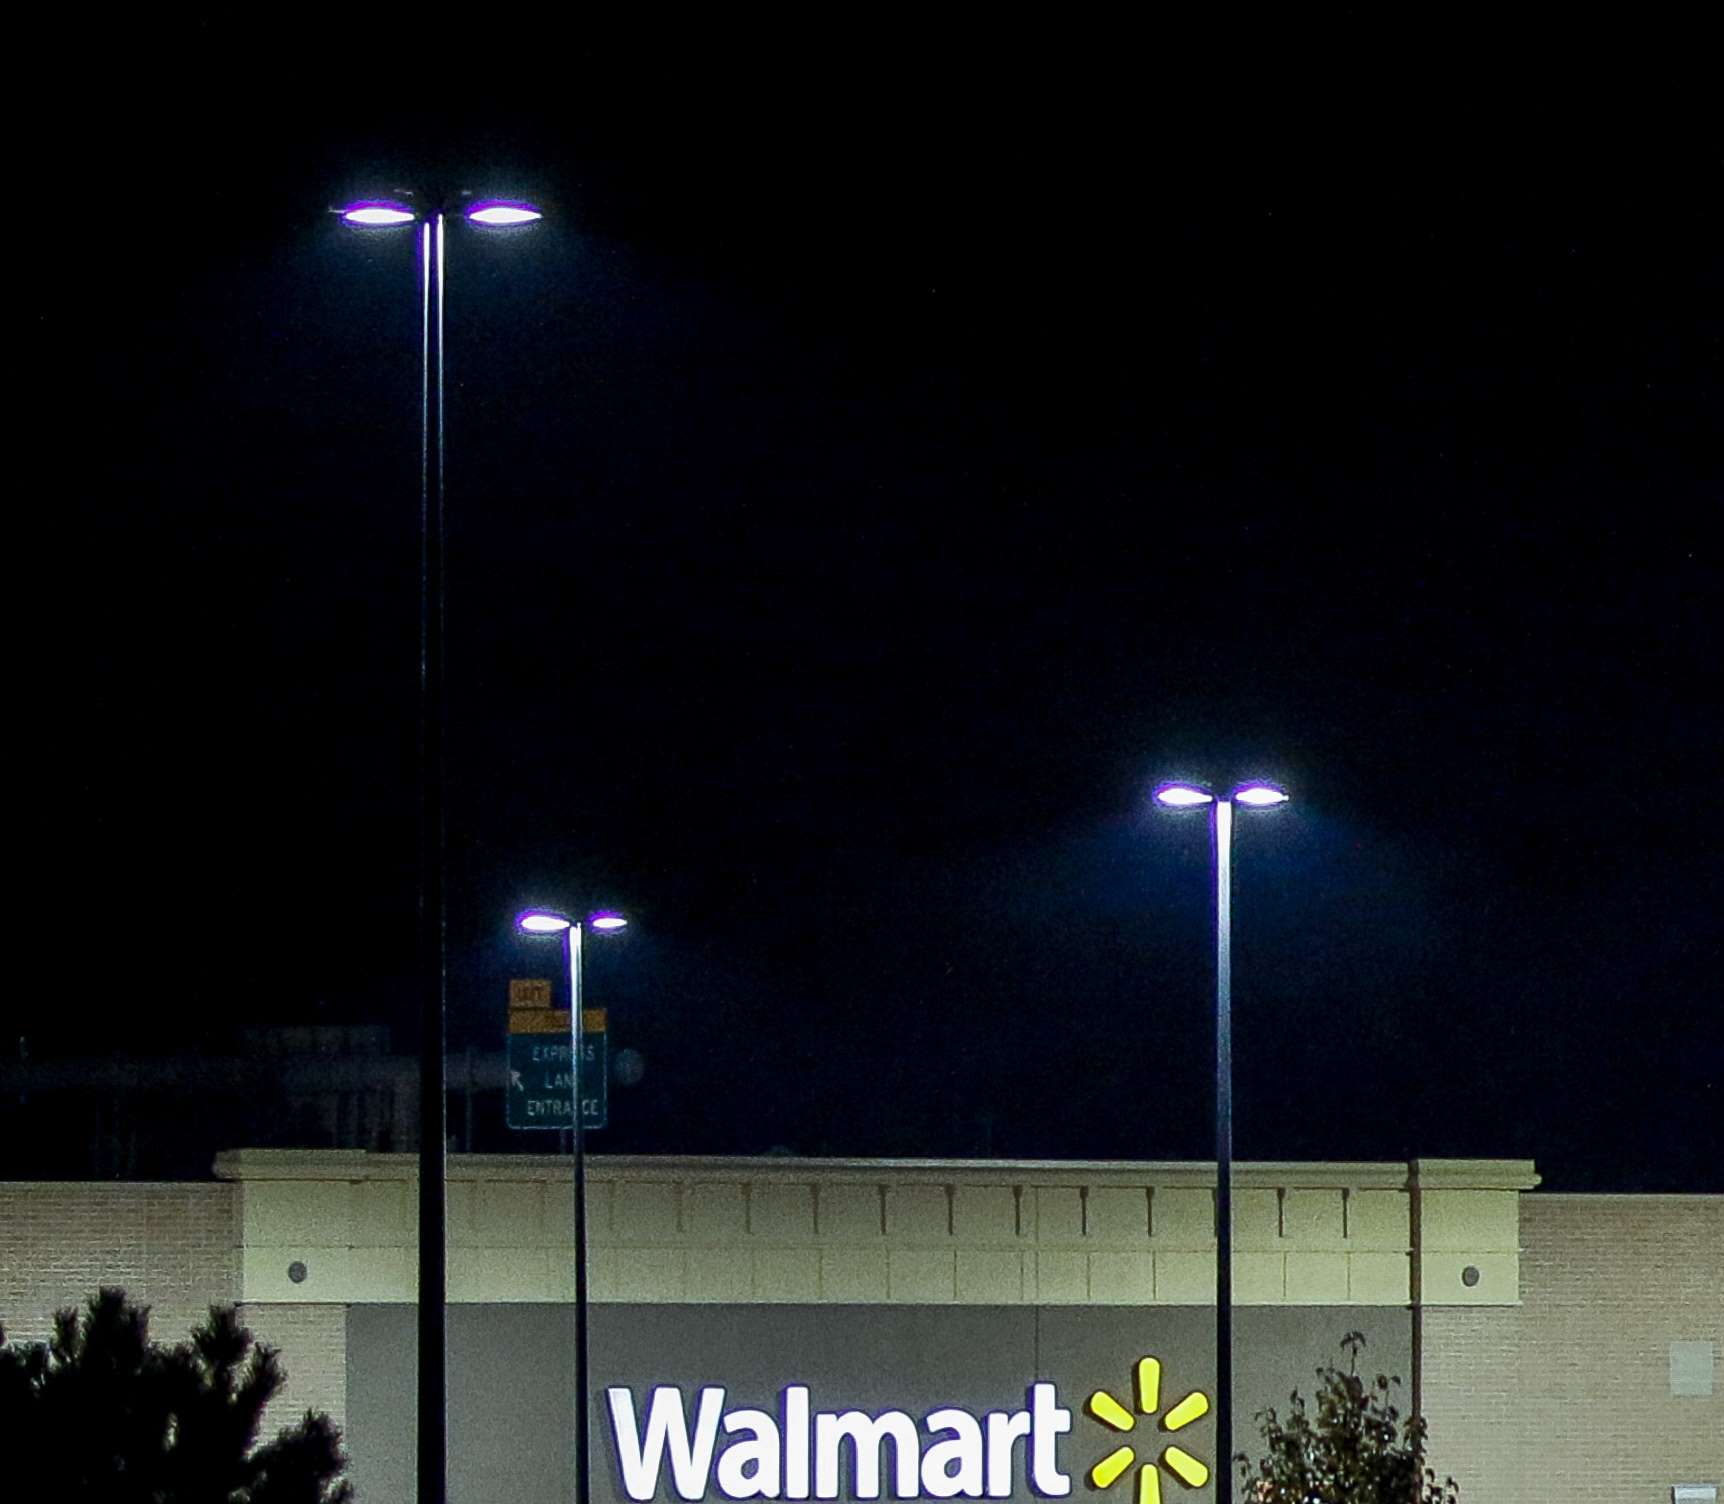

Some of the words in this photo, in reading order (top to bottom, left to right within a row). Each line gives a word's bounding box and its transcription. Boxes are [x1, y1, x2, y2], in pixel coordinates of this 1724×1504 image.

[532, 1045, 595, 1061] EXPRS
[544, 1072, 583, 1089] LAN
[527, 1099, 599, 1116] ENTRACE
[607, 1383, 1071, 1501] Walmart
